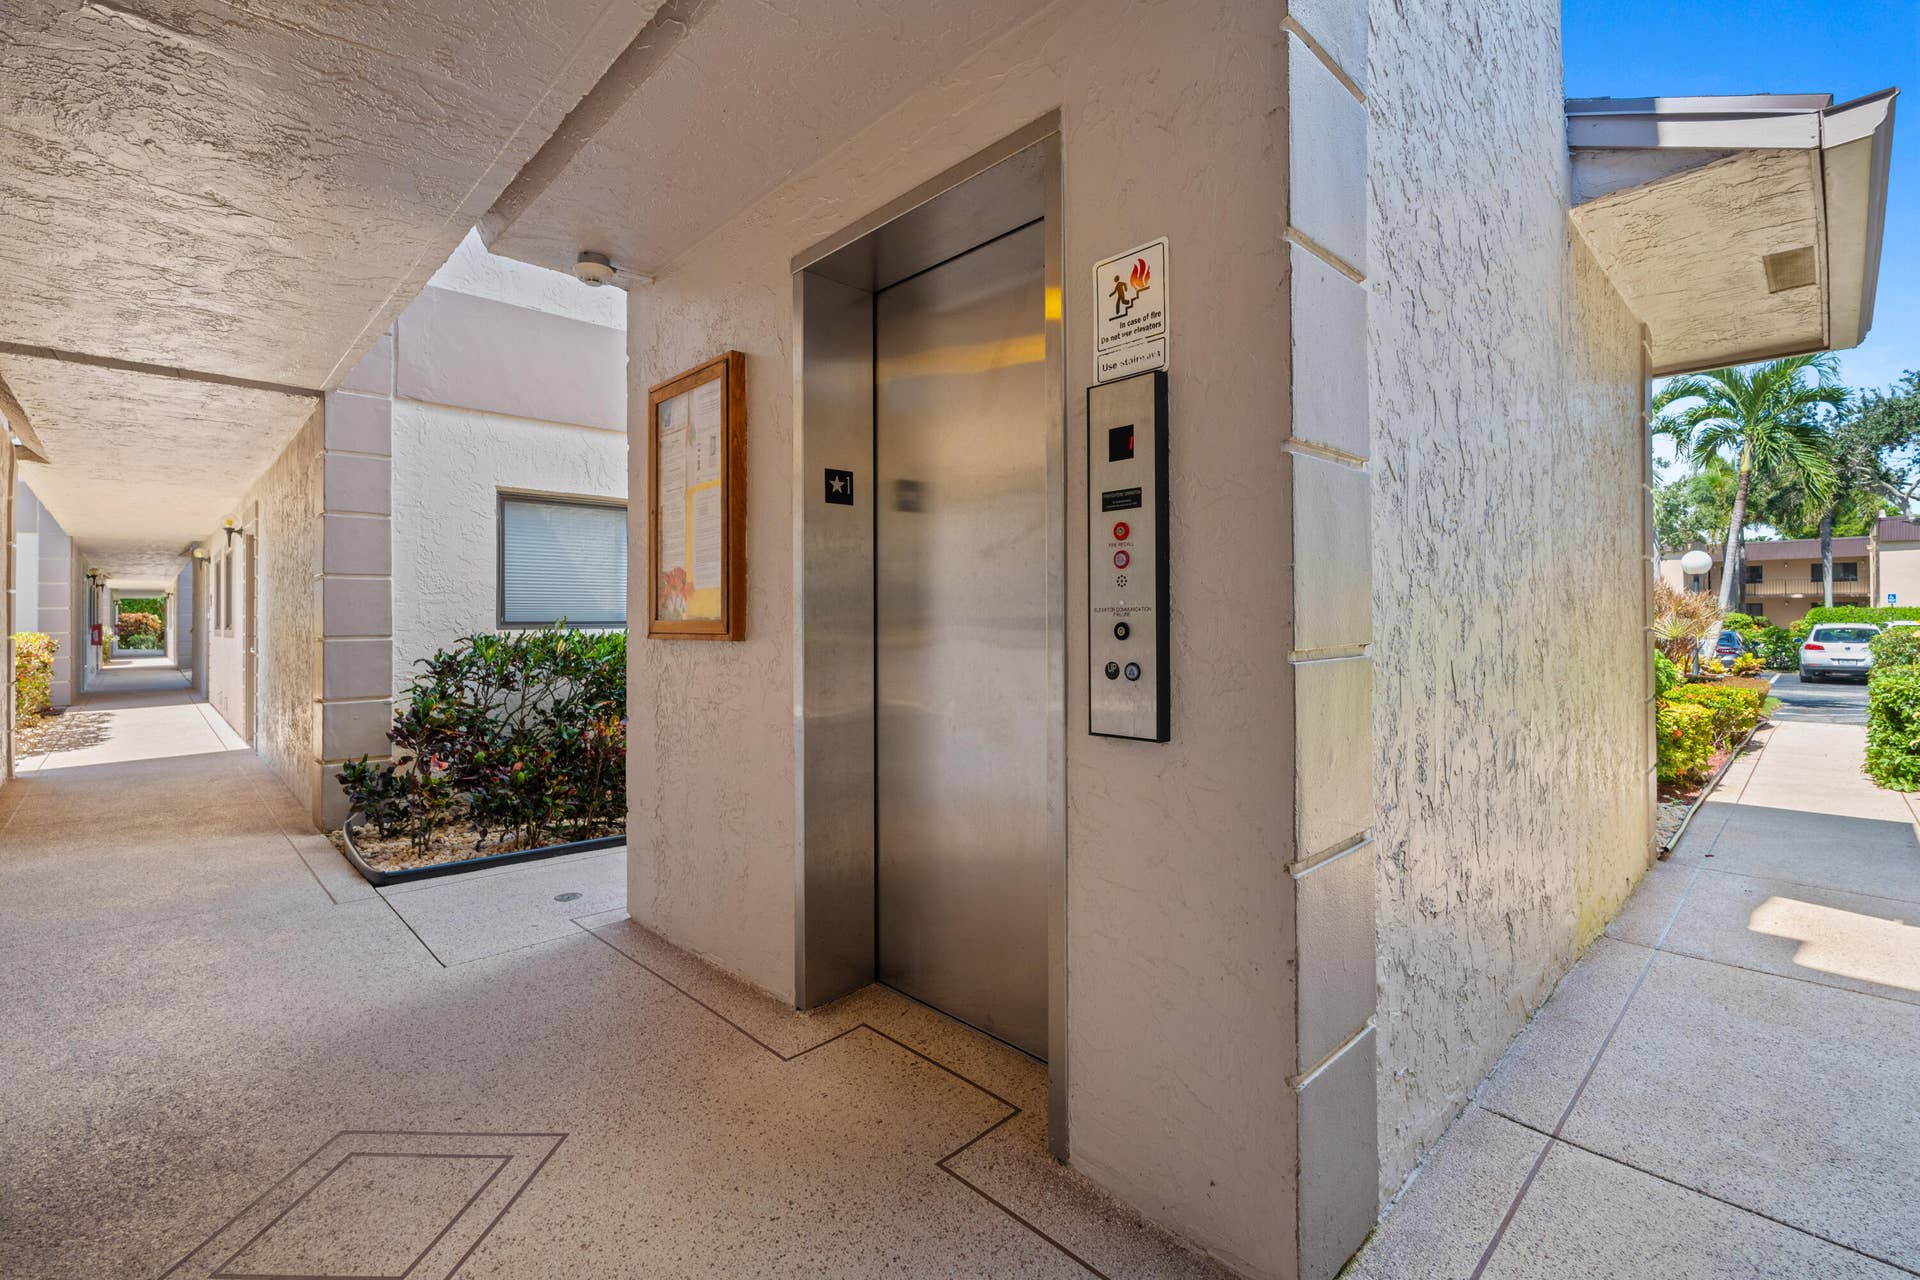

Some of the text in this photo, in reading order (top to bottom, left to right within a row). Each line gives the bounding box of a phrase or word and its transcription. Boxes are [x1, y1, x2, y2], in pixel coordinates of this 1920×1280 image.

[1127, 317, 1141, 327] case
[1143, 312, 1149, 322] of
[1150, 311, 1162, 319] fire
[1100, 336, 1109, 344] Do
[1110, 332, 1121, 341] not
[1133, 321, 1162, 334] elevators
[1102, 362, 1117, 371] Use
[1107, 663, 1117, 673] UP
